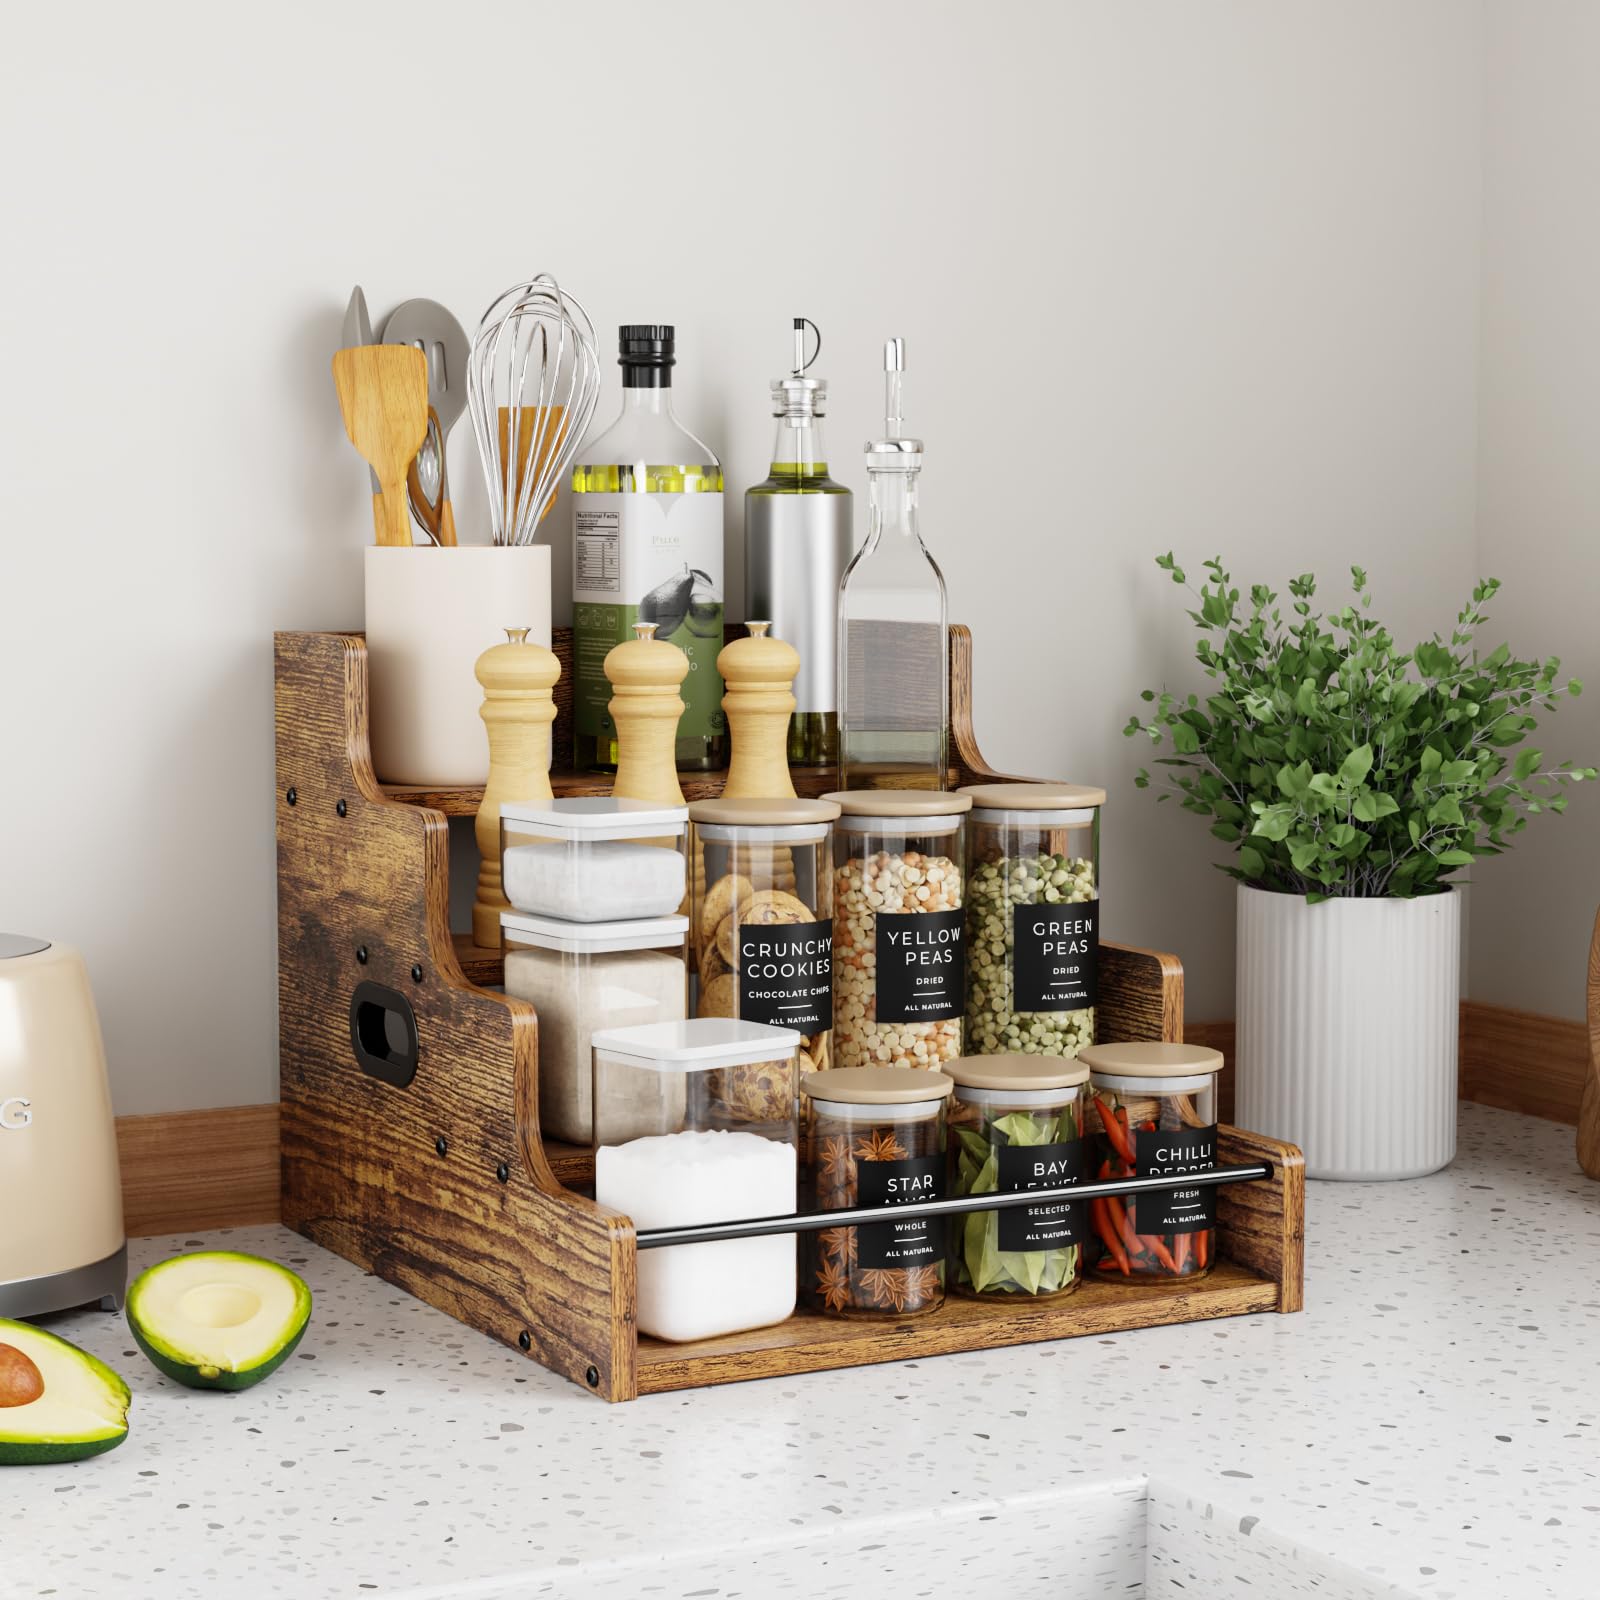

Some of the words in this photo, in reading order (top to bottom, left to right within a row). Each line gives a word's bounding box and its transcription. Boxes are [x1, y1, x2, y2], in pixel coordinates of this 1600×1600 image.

[1032, 918, 1093, 936] GREEN
[887, 927, 961, 946] YELLOW
[742, 937, 832, 957] CRUNCHY
[1043, 939, 1088, 956] PEAS
[905, 949, 953, 966] PEAS
[747, 959, 830, 978] COOKIES
[1053, 966, 1080, 975] DRIED
[916, 976, 944, 985] DRIED
[748, 989, 808, 998] CHOCOLATE
[810, 985, 830, 996] CHIPS
[1058, 991, 1088, 1000] NATURAL
[921, 1002, 953, 1011] NATURAL
[787, 1015, 820, 1024] NATURAL
[1155, 1143, 1211, 1161] CHILLI
[1034, 1160, 1068, 1176] BAY
[887, 1174, 934, 1192] STAR
[1173, 1190, 1200, 1199] FRESH
[1028, 1204, 1071, 1216] SELECTED
[1179, 1213, 1207, 1223] NATURAL
[894, 1221, 927, 1232] WHOLE
[1042, 1229, 1072, 1239] NATURAL
[903, 1246, 934, 1256] NATURAL
